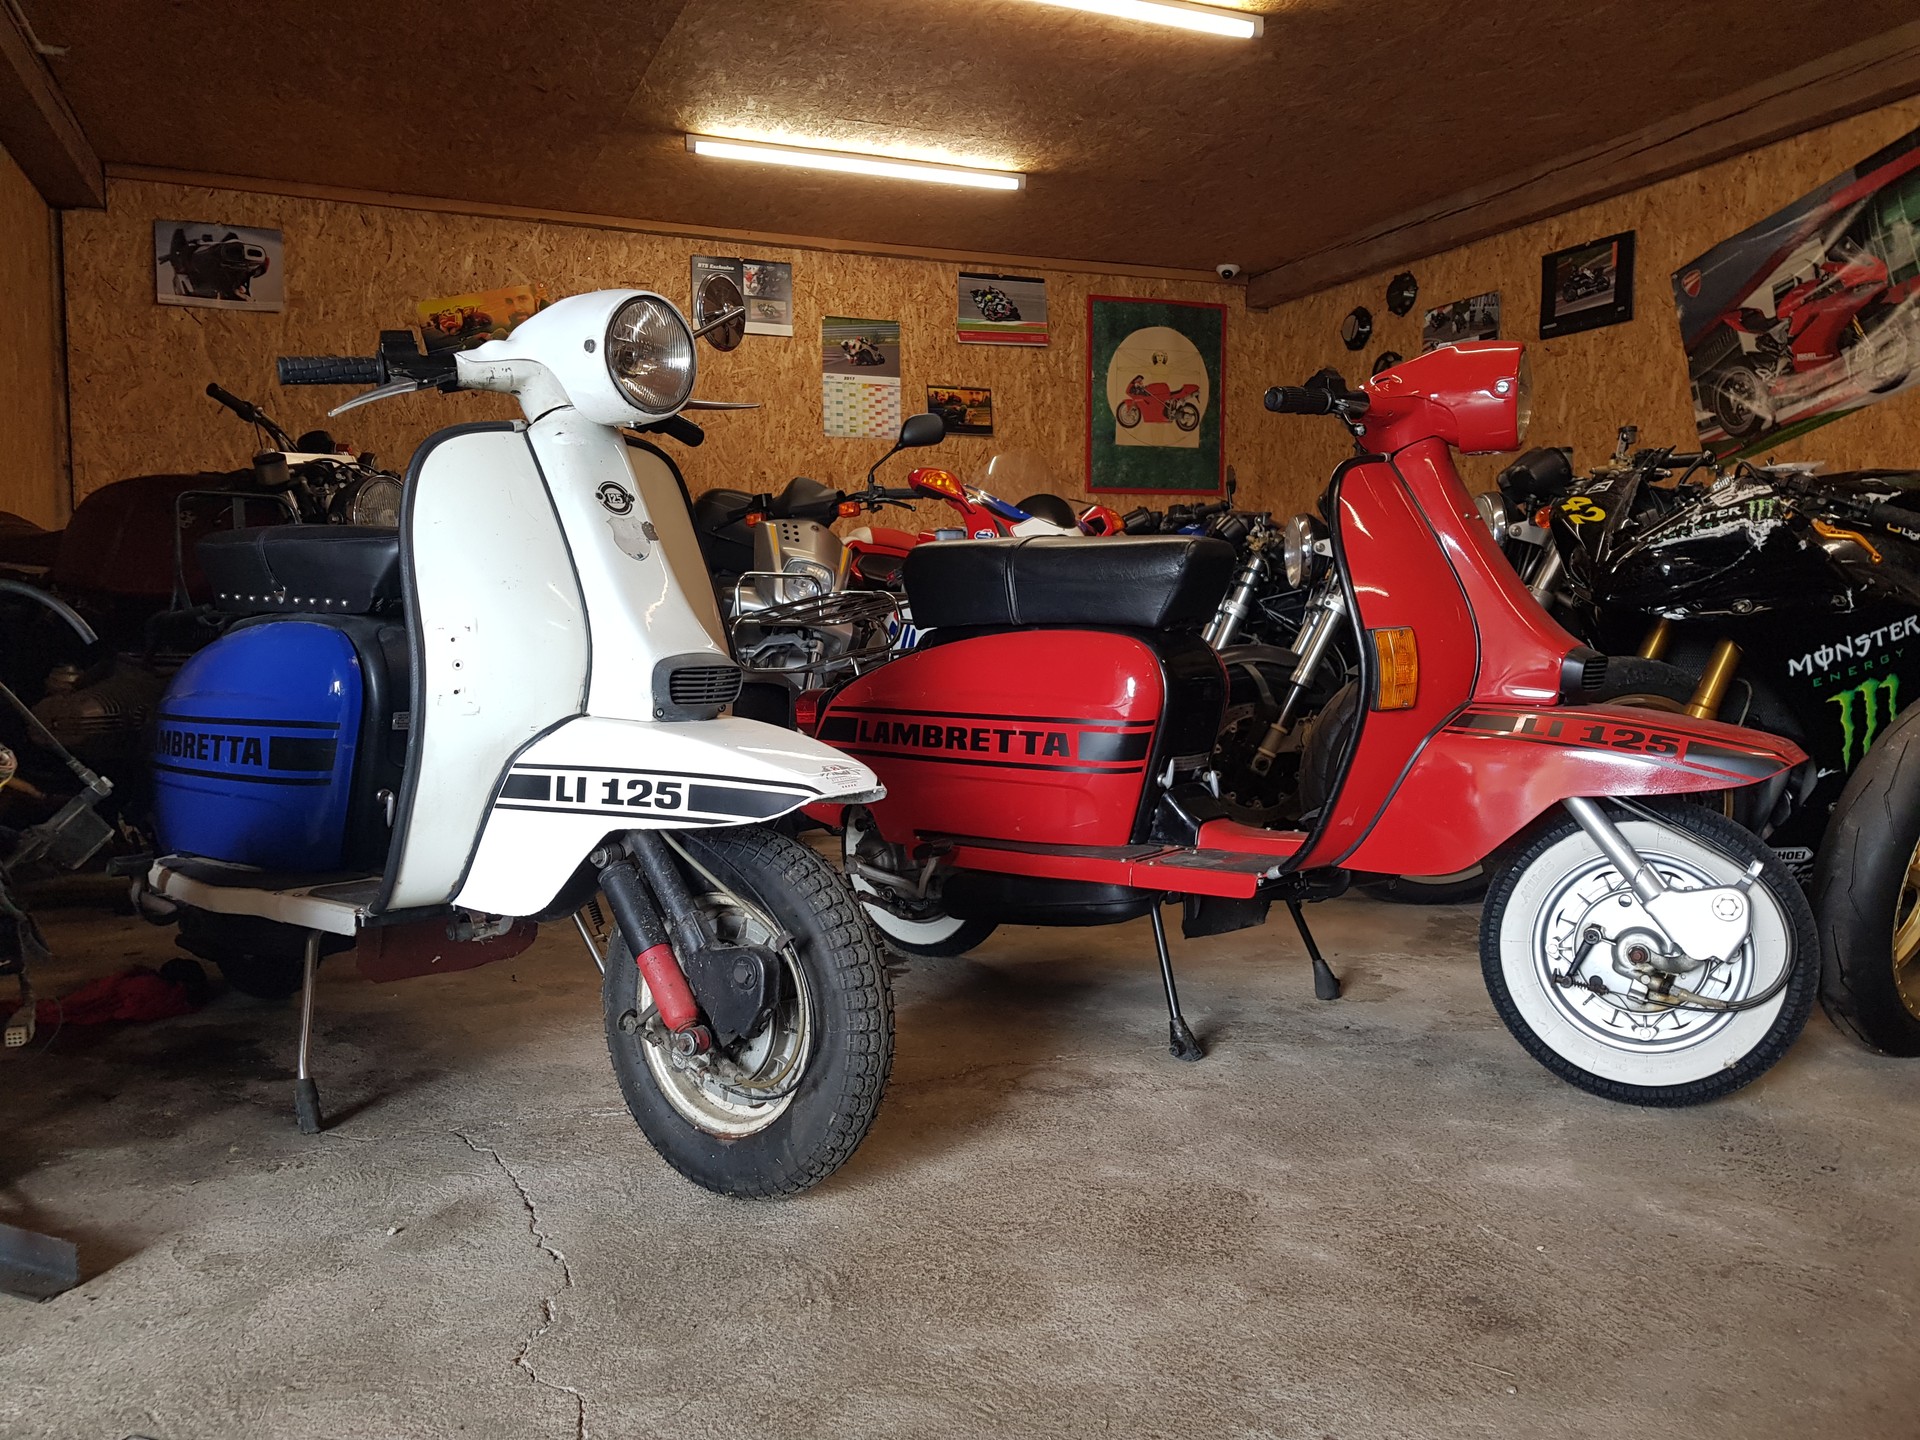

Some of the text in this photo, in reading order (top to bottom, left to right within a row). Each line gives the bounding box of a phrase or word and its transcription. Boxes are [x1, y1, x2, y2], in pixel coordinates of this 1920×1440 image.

[606, 493, 624, 504] 125
[1561, 496, 1606, 525] 42
[1788, 615, 1920, 677] MONSTER
[1813, 648, 1904, 688] ENERGY
[155, 729, 263, 767] MBRETTA
[859, 720, 1071, 758] LAMBRETTA
[1521, 718, 1681, 760] LI 125
[556, 775, 682, 810] LI 125
[1775, 851, 1806, 860] HOEI
